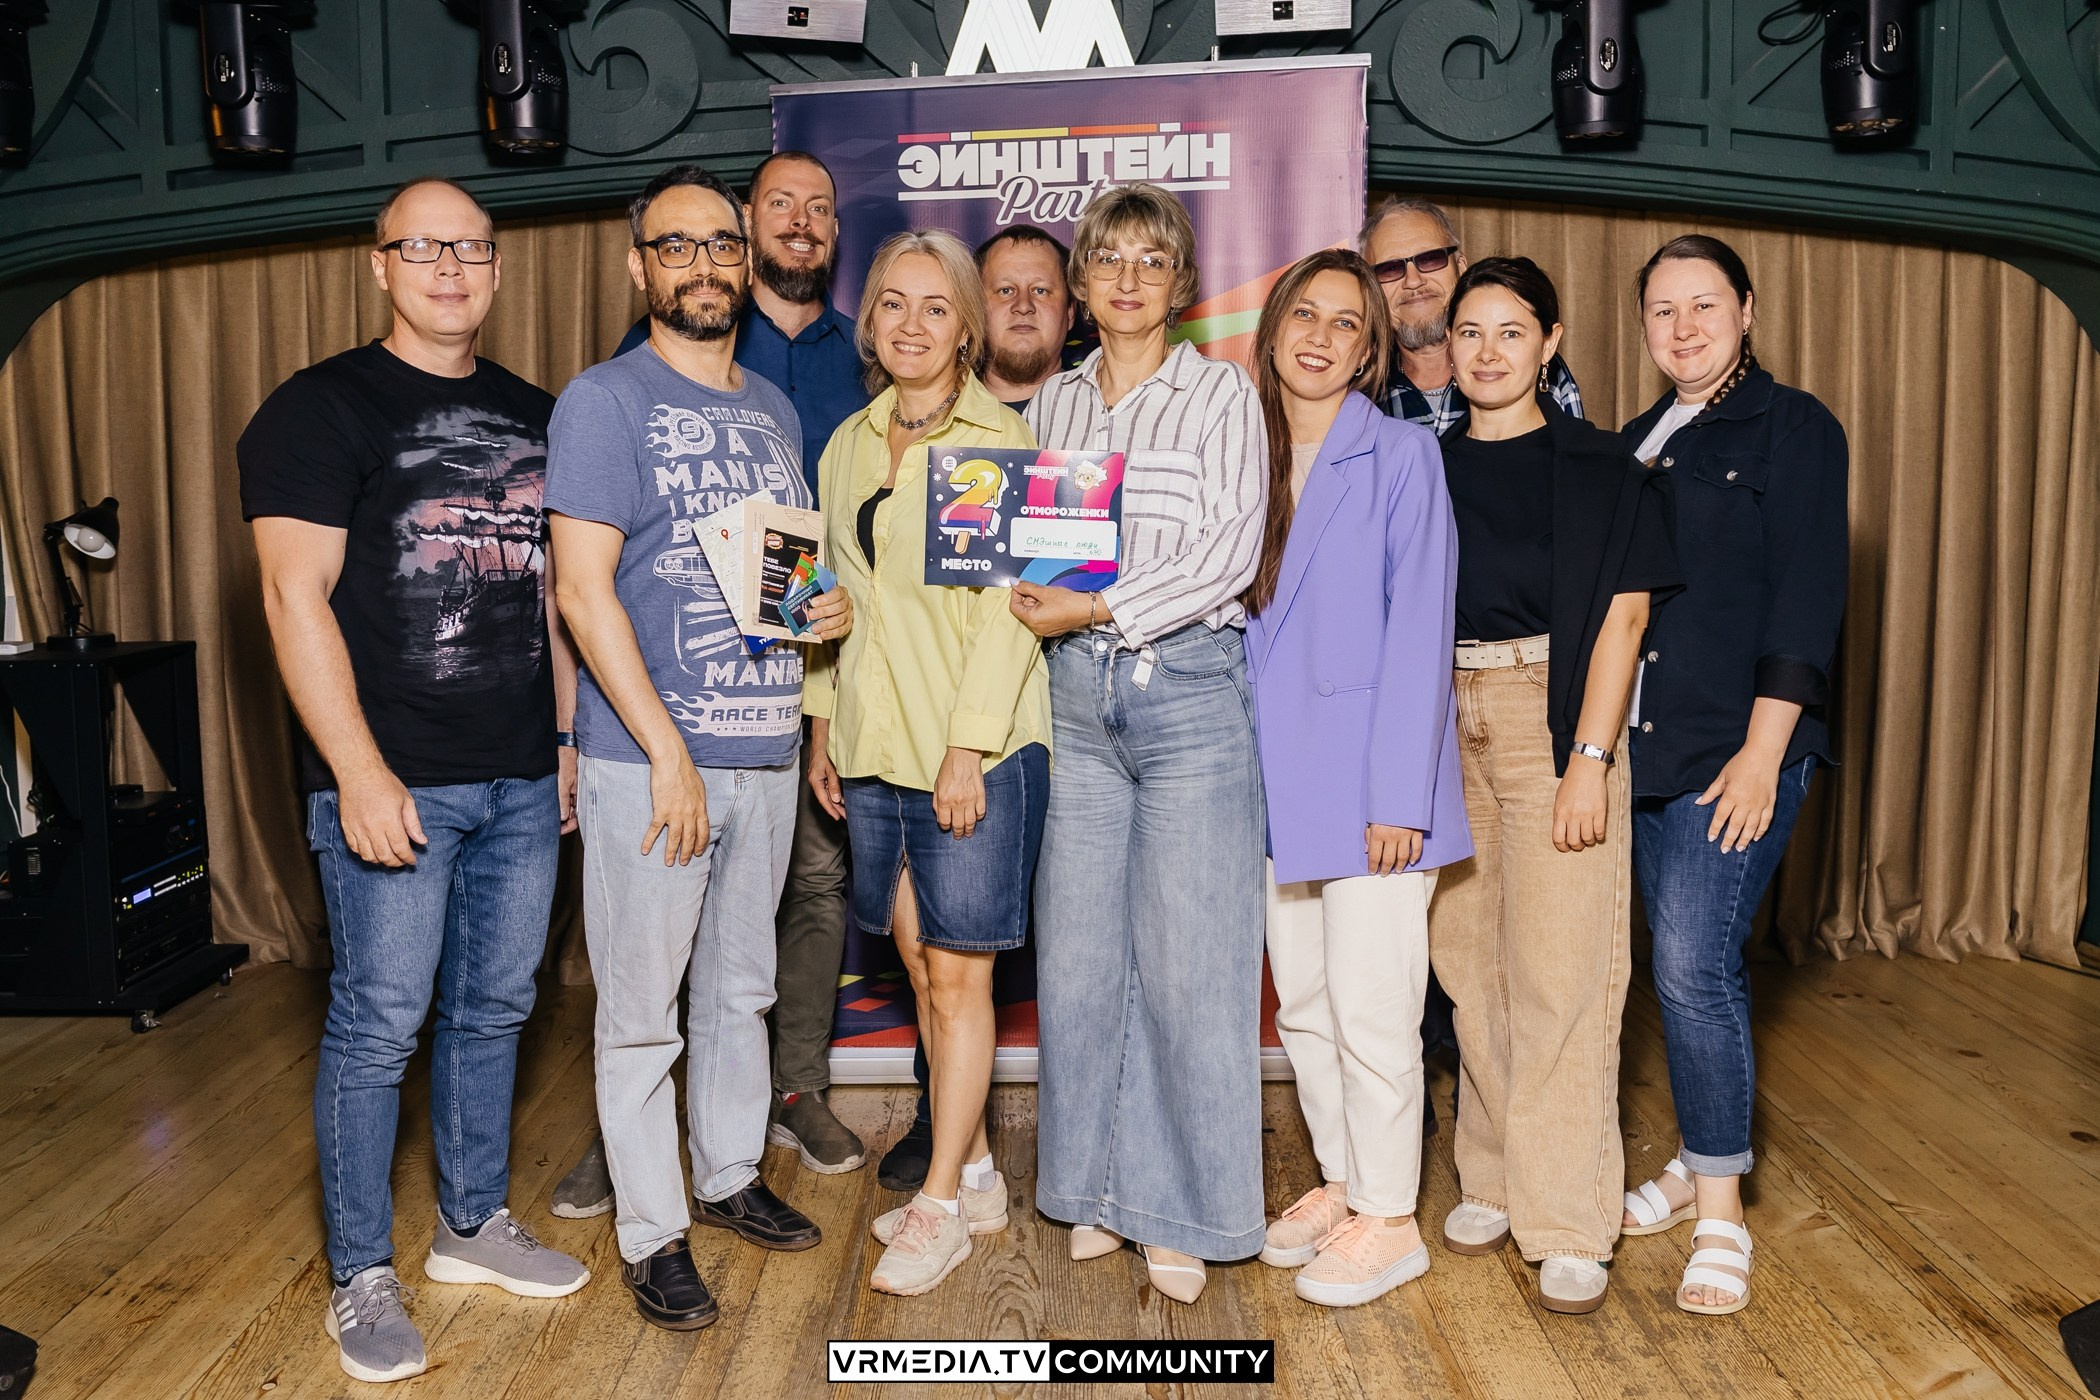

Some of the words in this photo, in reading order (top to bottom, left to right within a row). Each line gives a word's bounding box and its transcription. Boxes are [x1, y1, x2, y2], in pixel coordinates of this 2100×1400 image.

[898, 122, 1231, 188] ЭЙНШТЕЙН
[996, 174, 1110, 226] Part
[701, 406, 733, 421] CAR
[681, 421, 701, 440] 9
[726, 428, 753, 456] A
[653, 459, 751, 496] MAN
[752, 463, 788, 491] IS
[938, 458, 1009, 538] 2
[1020, 505, 1110, 518] ОТМОРОЖЕНКИ
[941, 557, 992, 571] МЕСТО
[710, 707, 768, 722] RACE
